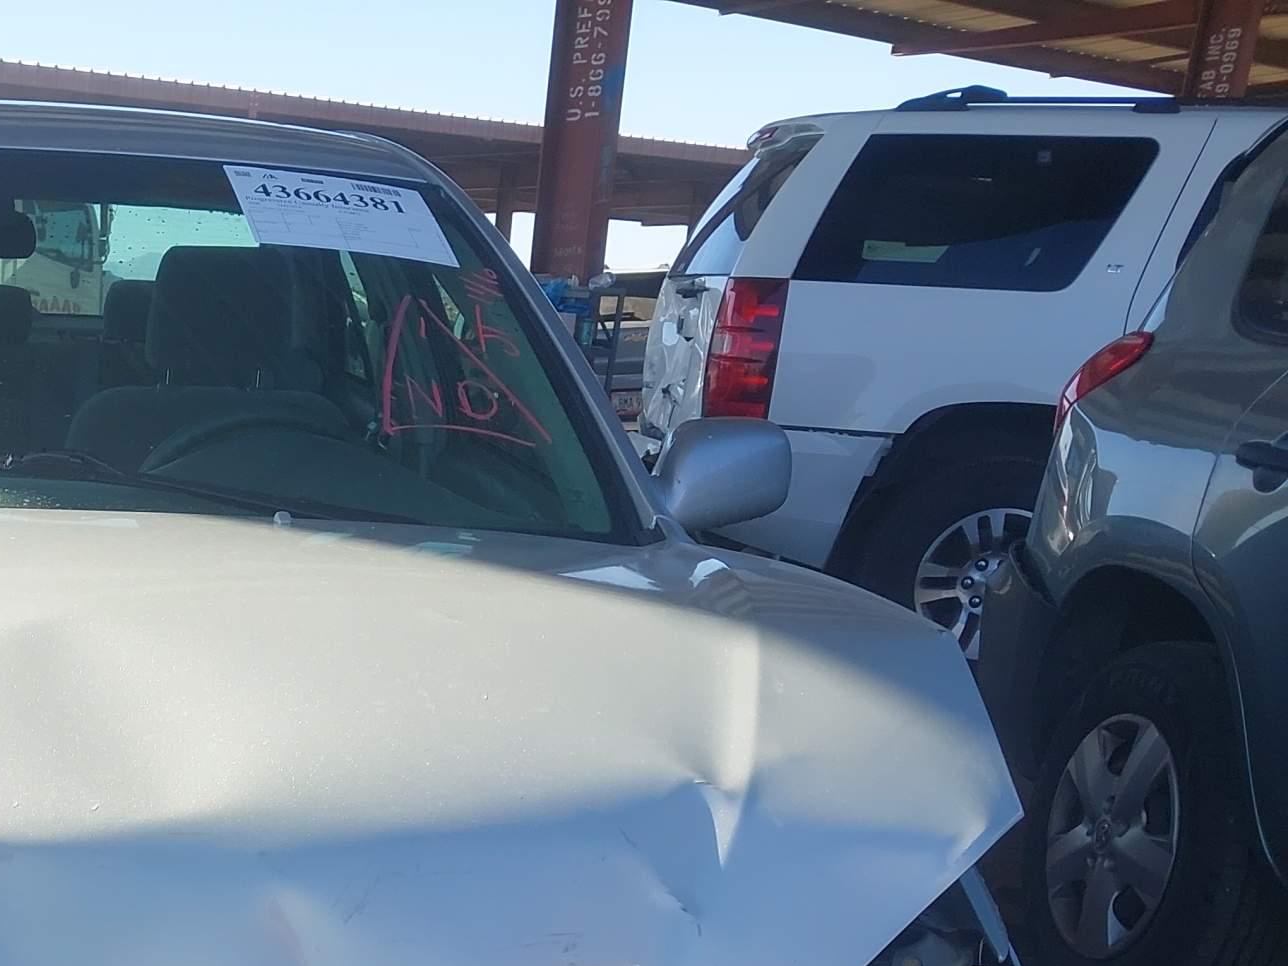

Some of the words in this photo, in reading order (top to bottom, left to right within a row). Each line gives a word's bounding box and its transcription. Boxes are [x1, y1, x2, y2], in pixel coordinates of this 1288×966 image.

[573, 0, 593, 64] PREF
[566, 78, 585, 121] U.S.
[253, 182, 407, 214] 43664381
